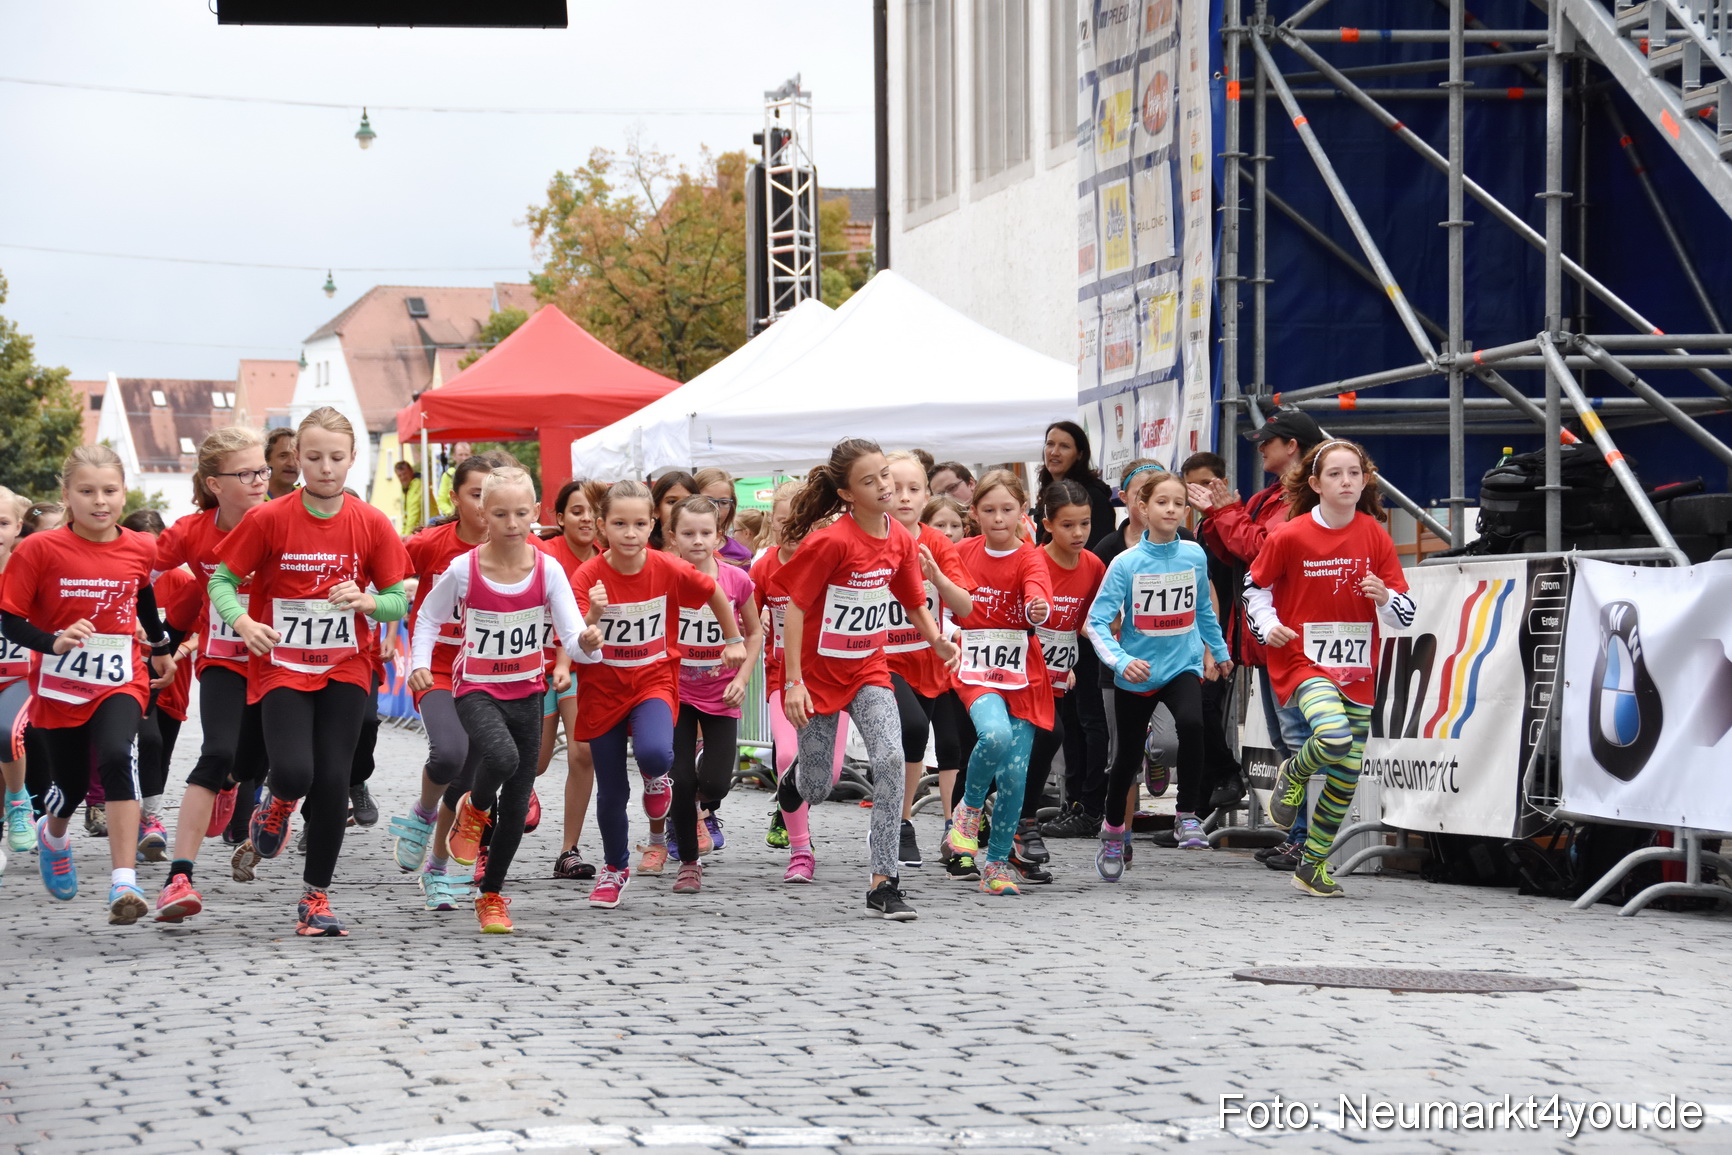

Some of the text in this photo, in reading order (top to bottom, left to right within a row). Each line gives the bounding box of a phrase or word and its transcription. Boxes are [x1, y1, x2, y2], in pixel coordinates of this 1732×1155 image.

[282, 552, 337, 562] Neumarkter
[1303, 558, 1353, 568] Neumarkter
[280, 563, 327, 573] Stadtlauf
[851, 568, 892, 579] Neumarkter
[1304, 567, 1343, 577] Stadtlauf
[60, 577, 120, 588] Neumarkter
[1540, 581, 1560, 591] Strom
[60, 589, 107, 600] Stadtlauf
[1140, 585, 1194, 612] 7175
[626, 600, 662, 614] BOCK
[503, 609, 540, 625] BOCK
[834, 602, 887, 632] 7202
[1153, 617, 1184, 628] Leonie
[283, 616, 350, 645] 7174
[600, 612, 661, 643] 7217
[679, 617, 726, 644] 715
[1338, 624, 1369, 633] BOCK
[87, 636, 126, 648] BOCK
[475, 623, 538, 655] 7194
[846, 637, 871, 649] Lucia
[887, 631, 922, 644] Sophie
[614, 648, 649, 658] Melina
[688, 648, 721, 660] Sophia
[1312, 639, 1367, 663] 7427
[302, 652, 329, 663] Lena
[967, 645, 1021, 670] 7164
[55, 650, 125, 683] 7413
[492, 662, 520, 673] Alina
[61, 680, 95, 695] Emma
